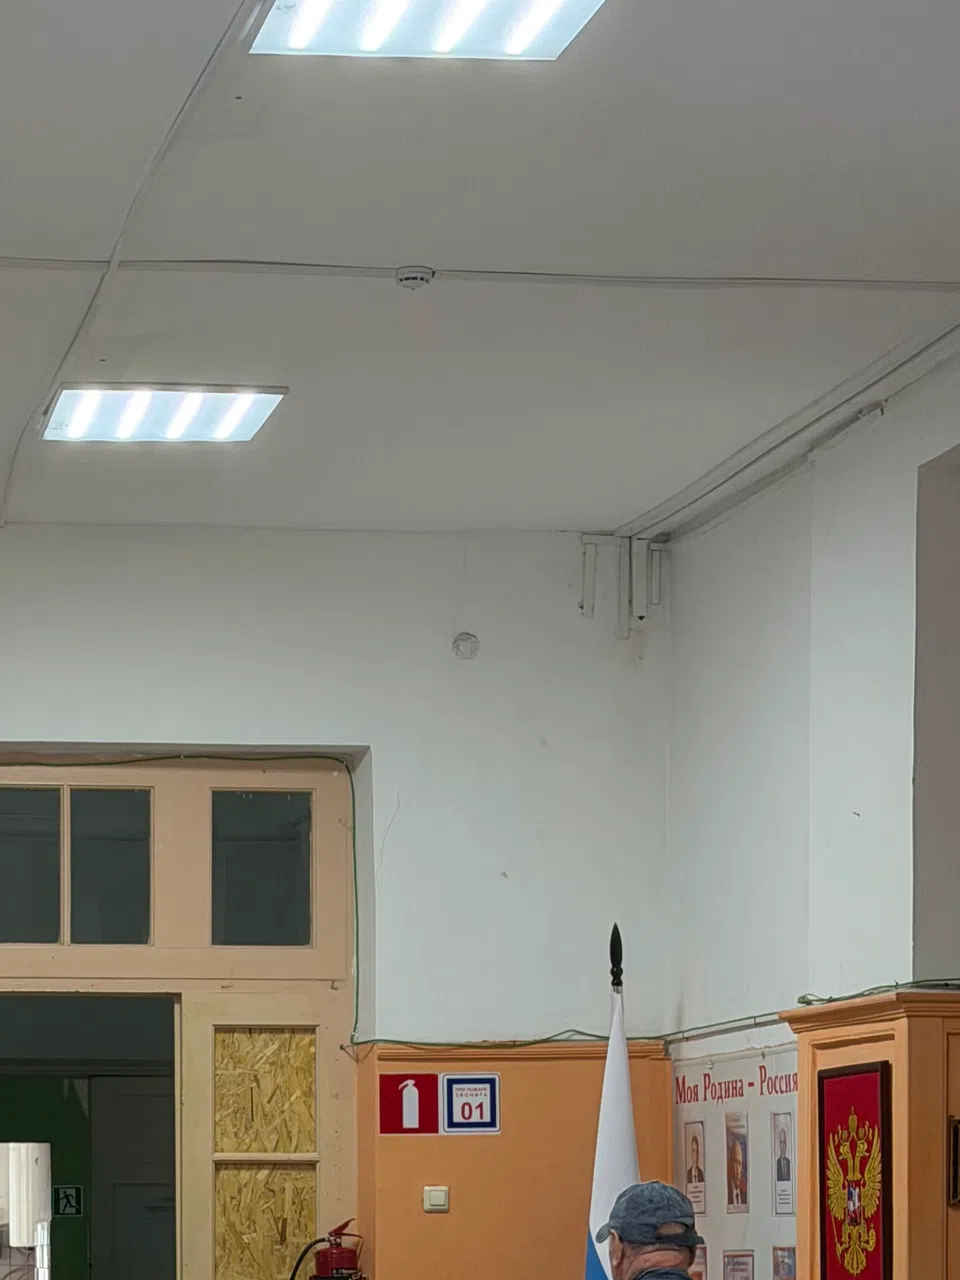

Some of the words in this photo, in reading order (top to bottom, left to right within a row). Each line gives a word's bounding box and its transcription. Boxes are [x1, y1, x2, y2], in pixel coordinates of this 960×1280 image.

[675, 1075, 699, 1104] Моя
[703, 1073, 744, 1106] Родина
[758, 1064, 798, 1096] Россия
[461, 1101, 484, 1121] 01
